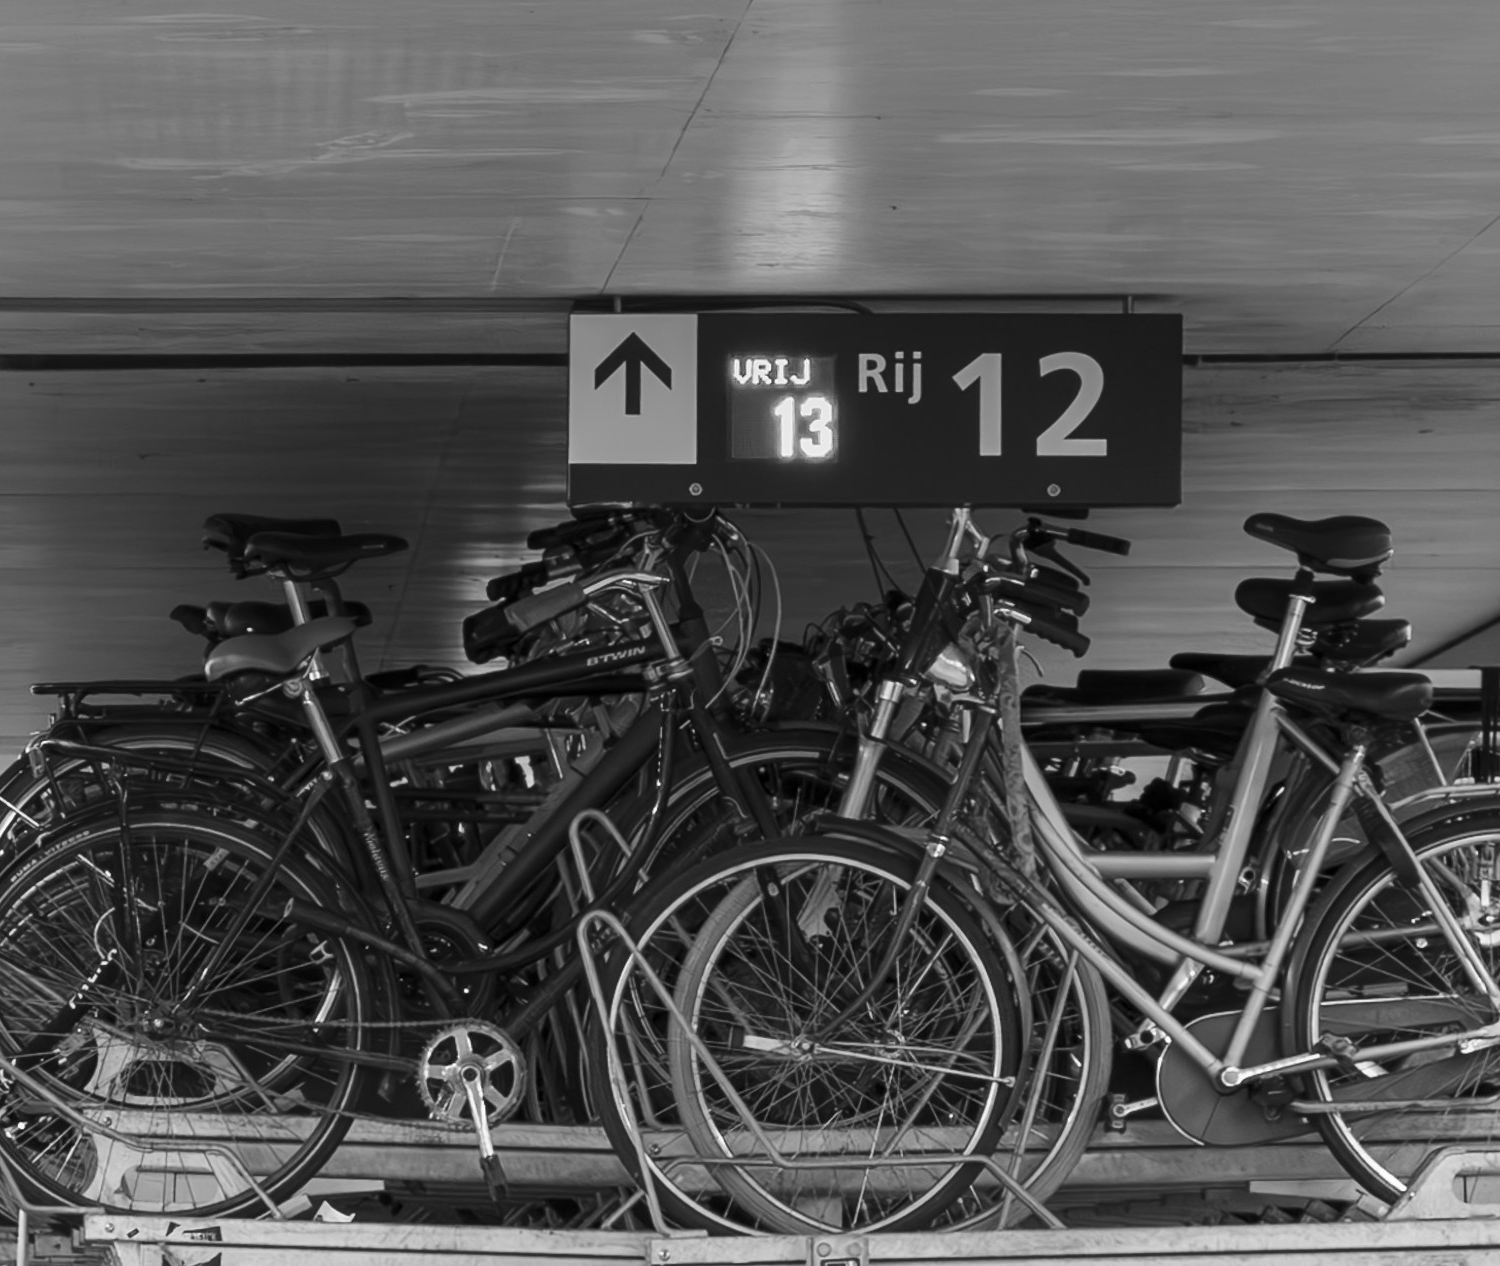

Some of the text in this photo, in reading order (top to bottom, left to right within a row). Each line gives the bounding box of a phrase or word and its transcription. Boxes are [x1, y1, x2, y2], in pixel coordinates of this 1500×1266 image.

[732, 357, 812, 386] VRIJ
[773, 395, 835, 458] 13
[857, 350, 1108, 457] Rij 12
